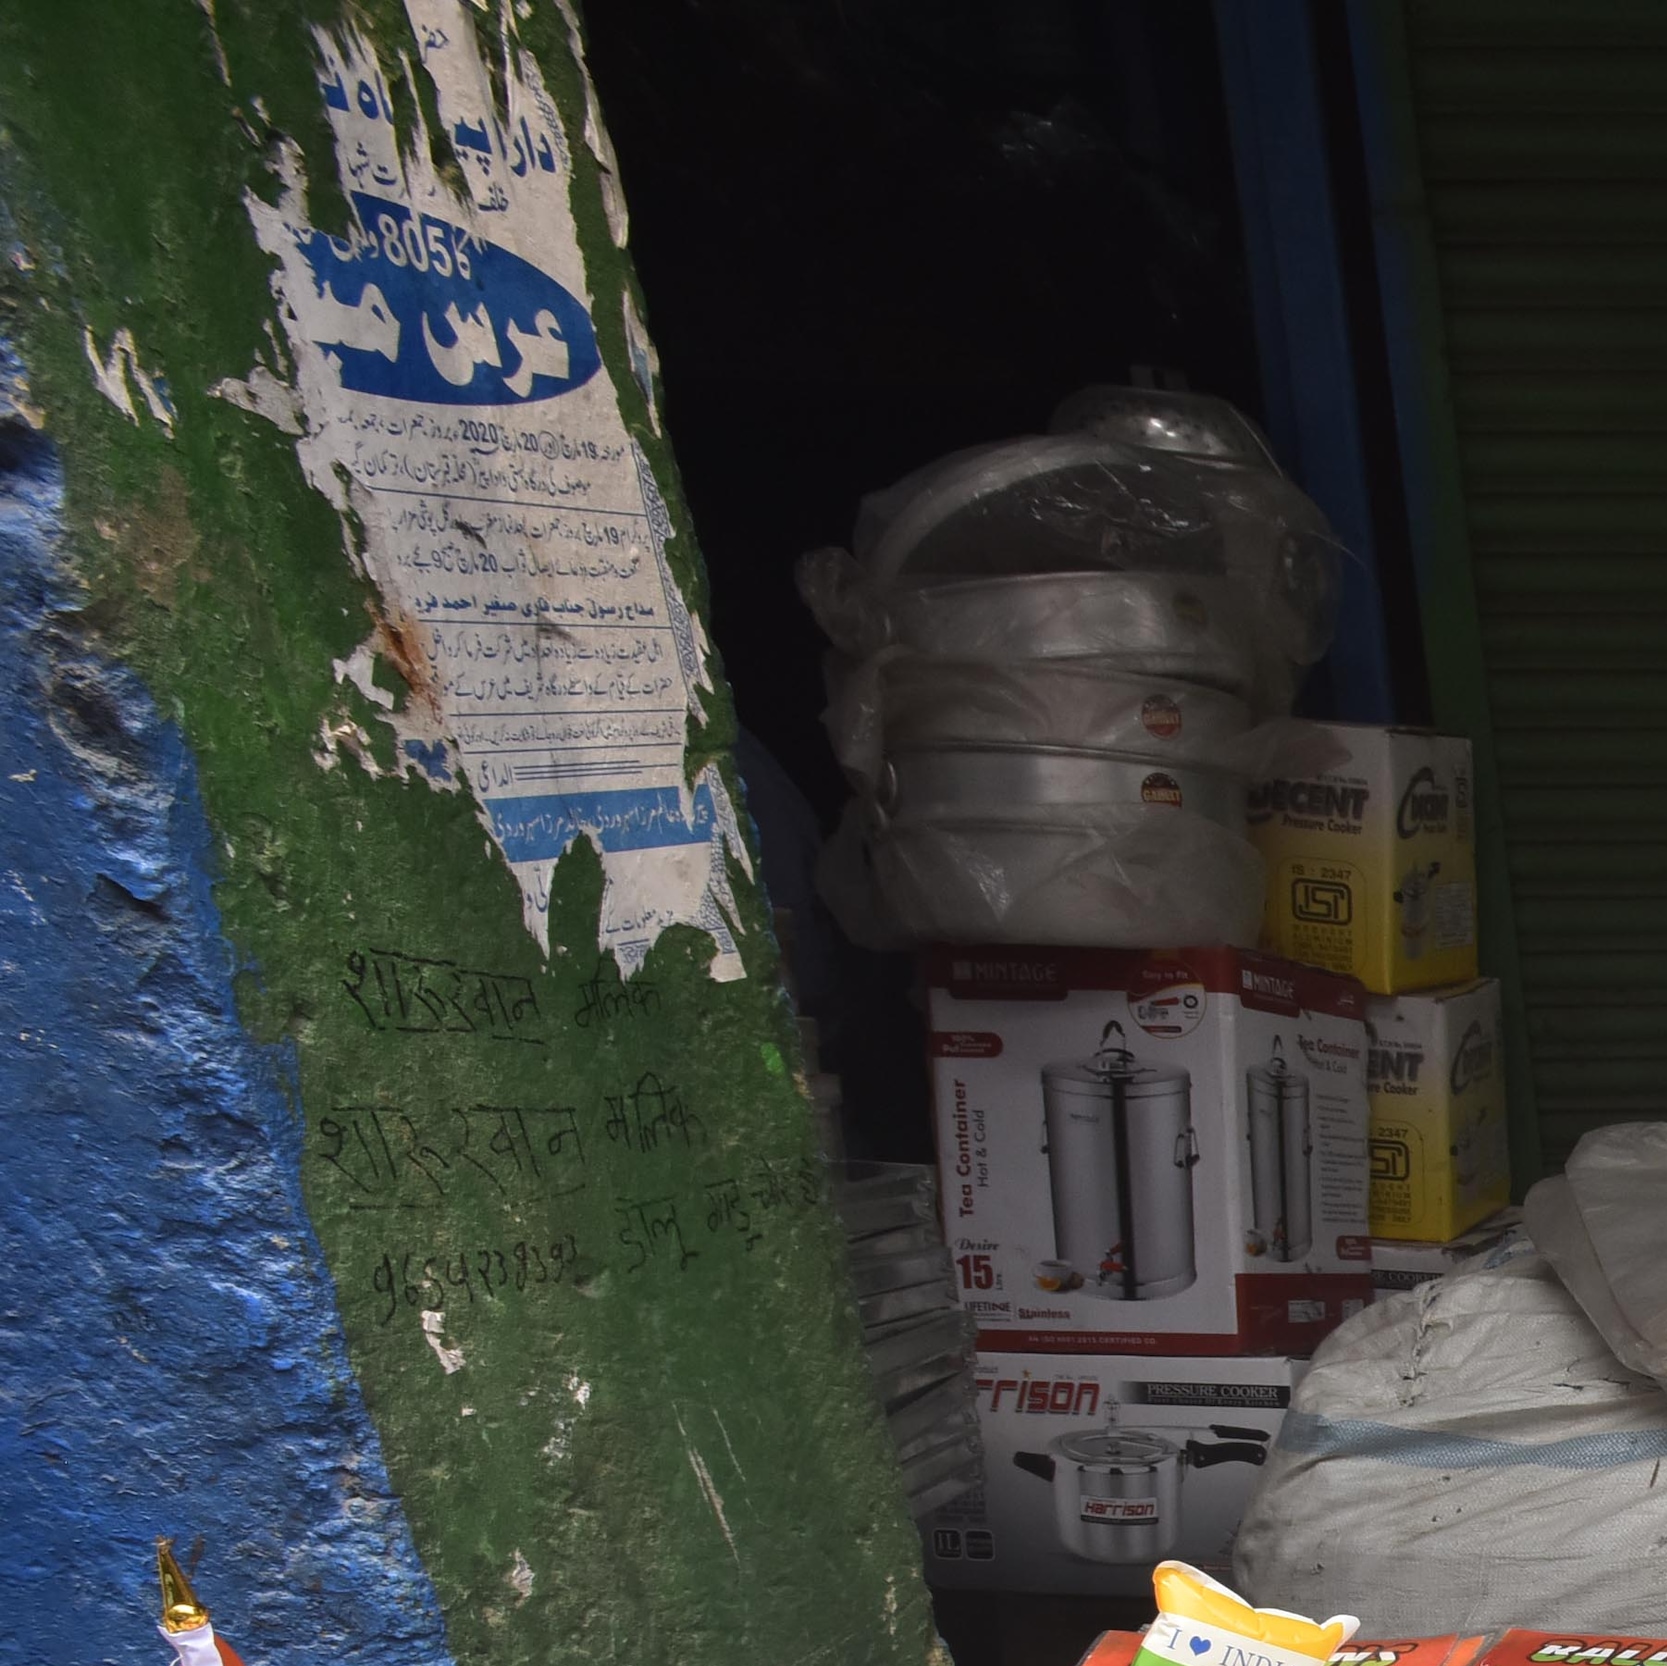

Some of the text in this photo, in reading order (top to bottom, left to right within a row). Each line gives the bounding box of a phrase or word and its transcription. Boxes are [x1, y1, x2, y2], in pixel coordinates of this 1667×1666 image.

[459, 419, 498, 444] 2020
[522, 432, 539, 453] 20
[581, 442, 598, 459] 19
[606, 526, 619, 545] 19
[431, 549, 442, 569] 9
[479, 552, 498, 573] 20
[1281, 816, 1363, 836] Pressure Cooker
[1321, 866, 1352, 880] 2347
[974, 961, 1058, 983] MINTAGE
[1252, 972, 1294, 998] MINTAGE
[1297, 1034, 1361, 1058] Tea Container
[1383, 1081, 1418, 1096] Cooker
[1378, 1126, 1408, 1138] 2347
[953, 1079, 974, 1218] Tea Container
[974, 1109, 989, 1189] Hot & Cold
[958, 1238, 1001, 1252] Desire
[956, 1254, 994, 1290] 15
[1018, 1308, 1071, 1319] Stainless
[1098, 1336, 1143, 1346] CERTIFIED
[1147, 1383, 1279, 1399] PRESSURE COOKER
[1084, 1499, 1155, 1518] Harrison
[1166, 1628, 1183, 1650] I
